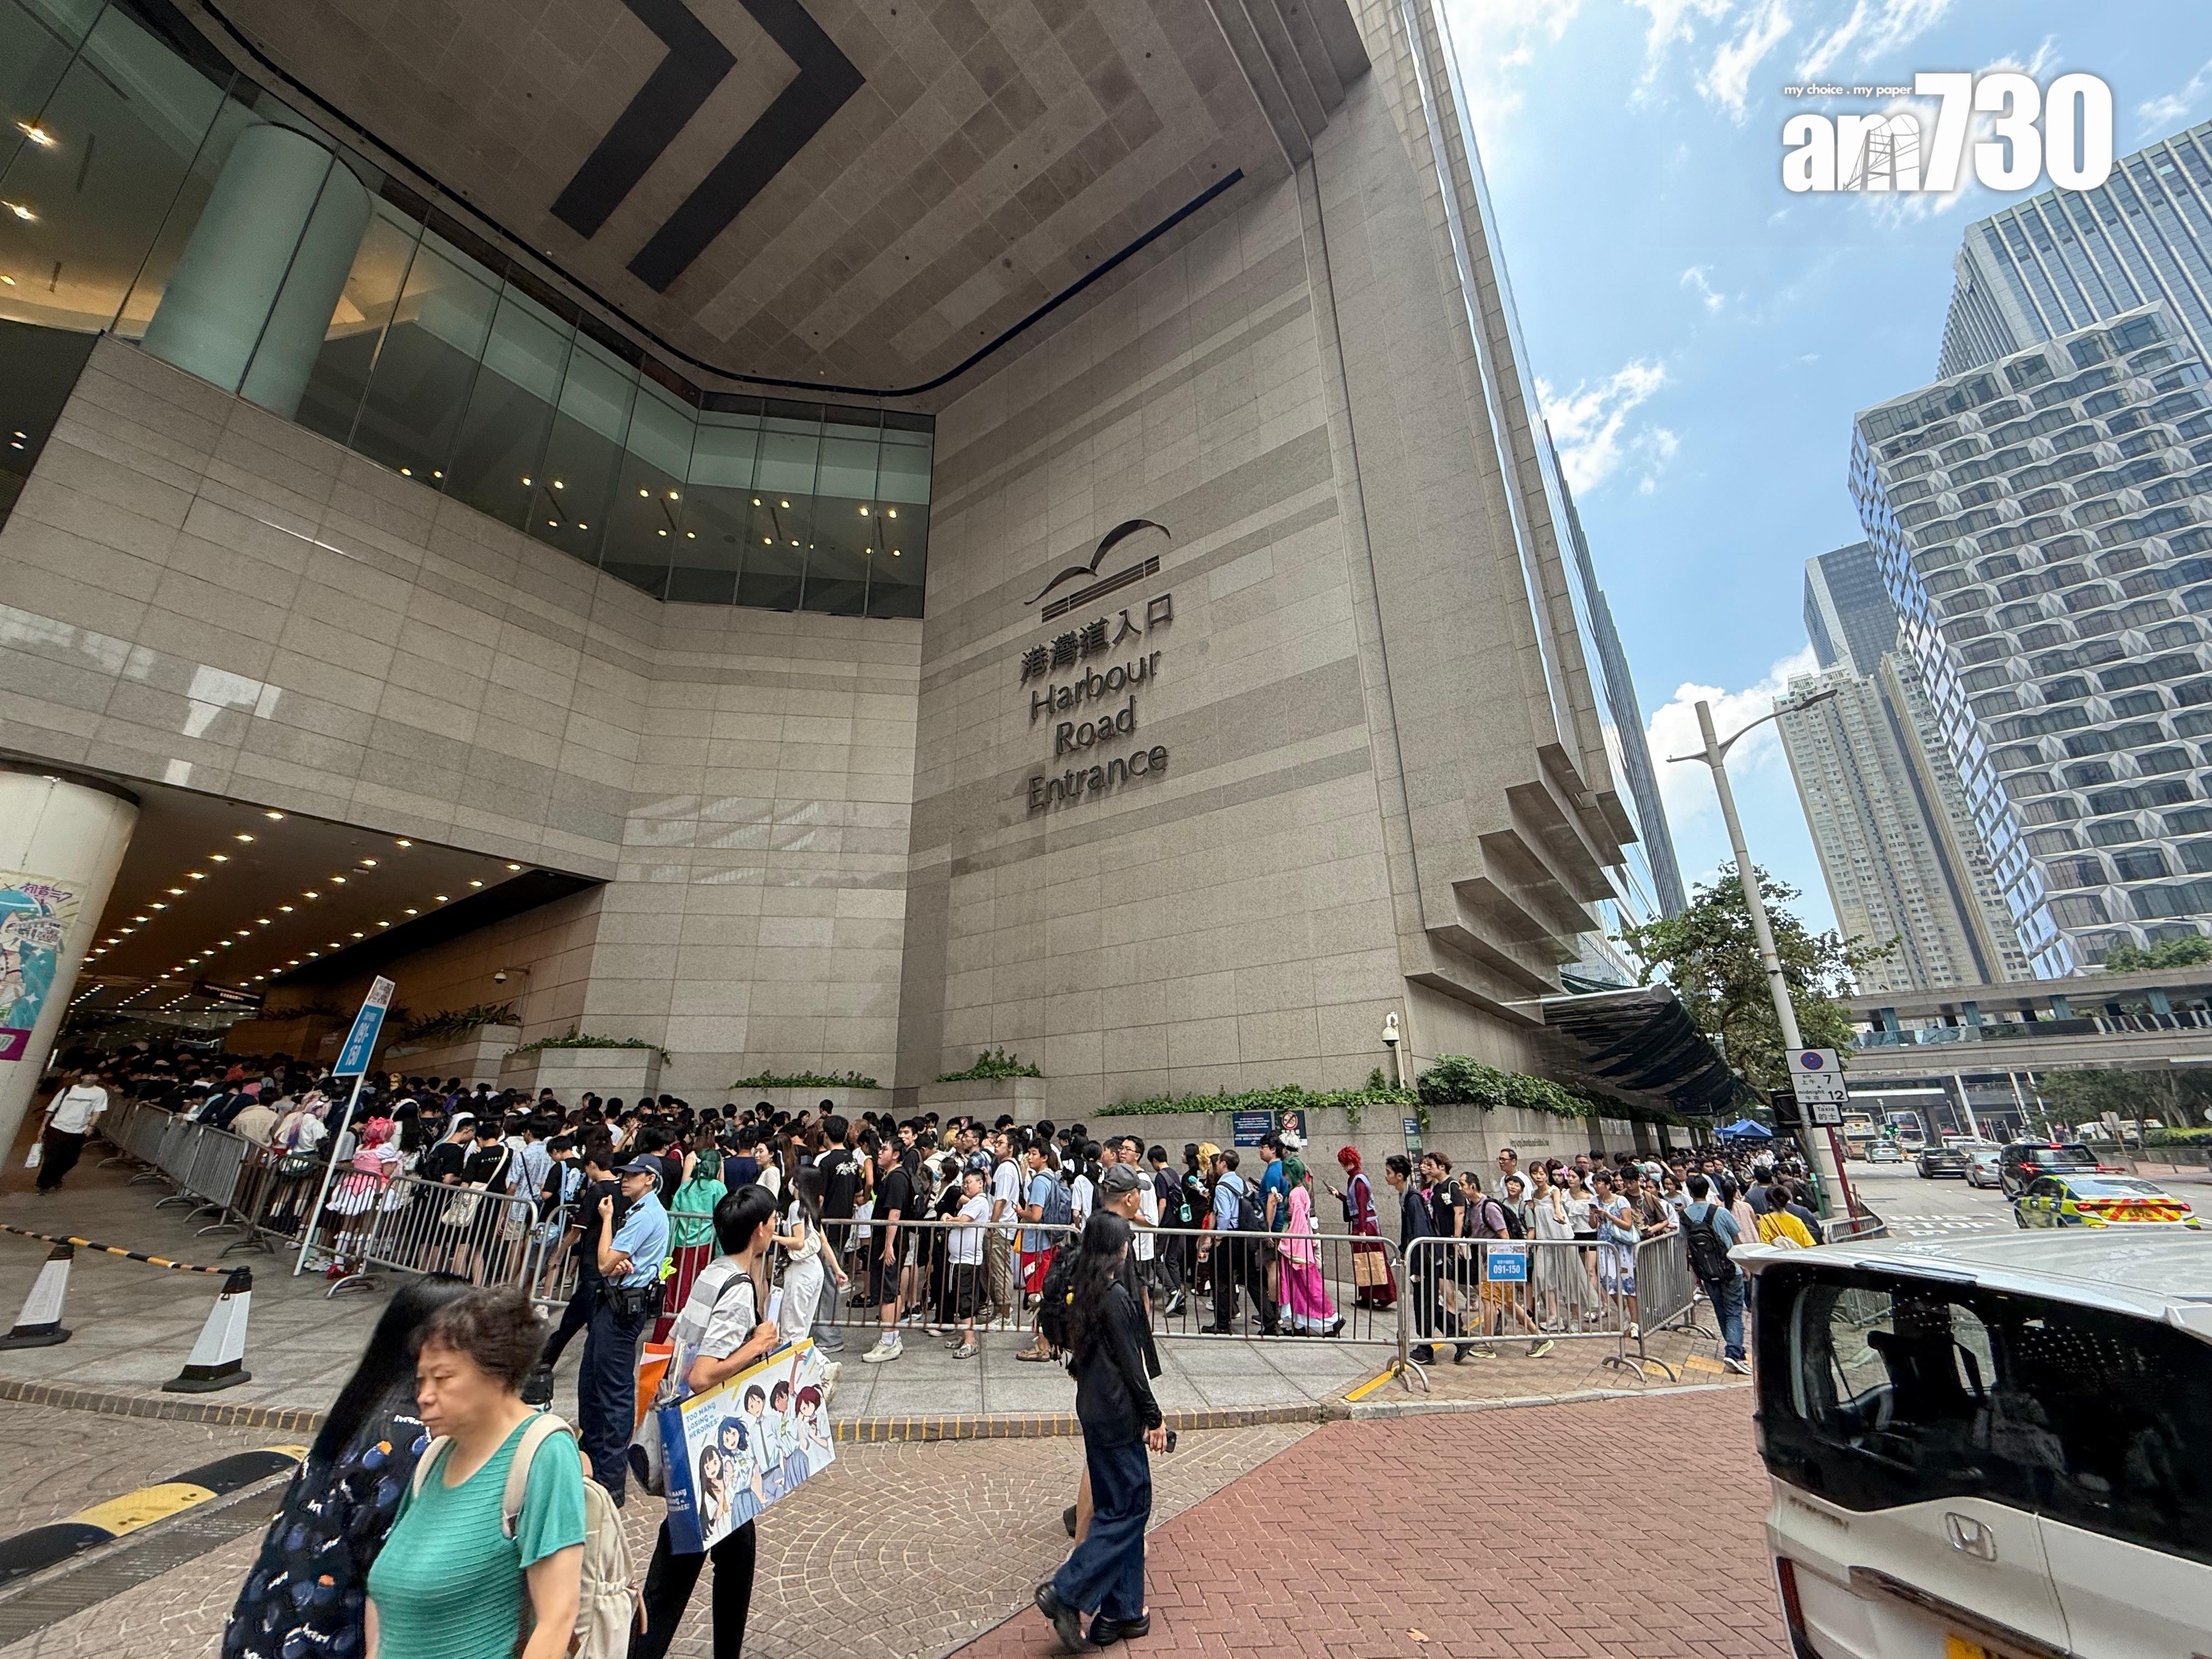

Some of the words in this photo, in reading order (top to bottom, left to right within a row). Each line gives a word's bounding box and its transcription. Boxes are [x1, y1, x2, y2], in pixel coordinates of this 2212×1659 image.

[1020, 593, 1174, 682] 港灣道入口
[1032, 650, 1161, 720] Harbour
[1056, 695, 1137, 754] Road
[1028, 744, 1169, 808] Entrance
[1822, 1075, 1831, 1084] 7
[1828, 1090, 1844, 1100] 12
[1493, 1264, 1520, 1274] 091-150
[686, 1412, 697, 1422] TOO
[688, 1414, 709, 1431] LOSING
